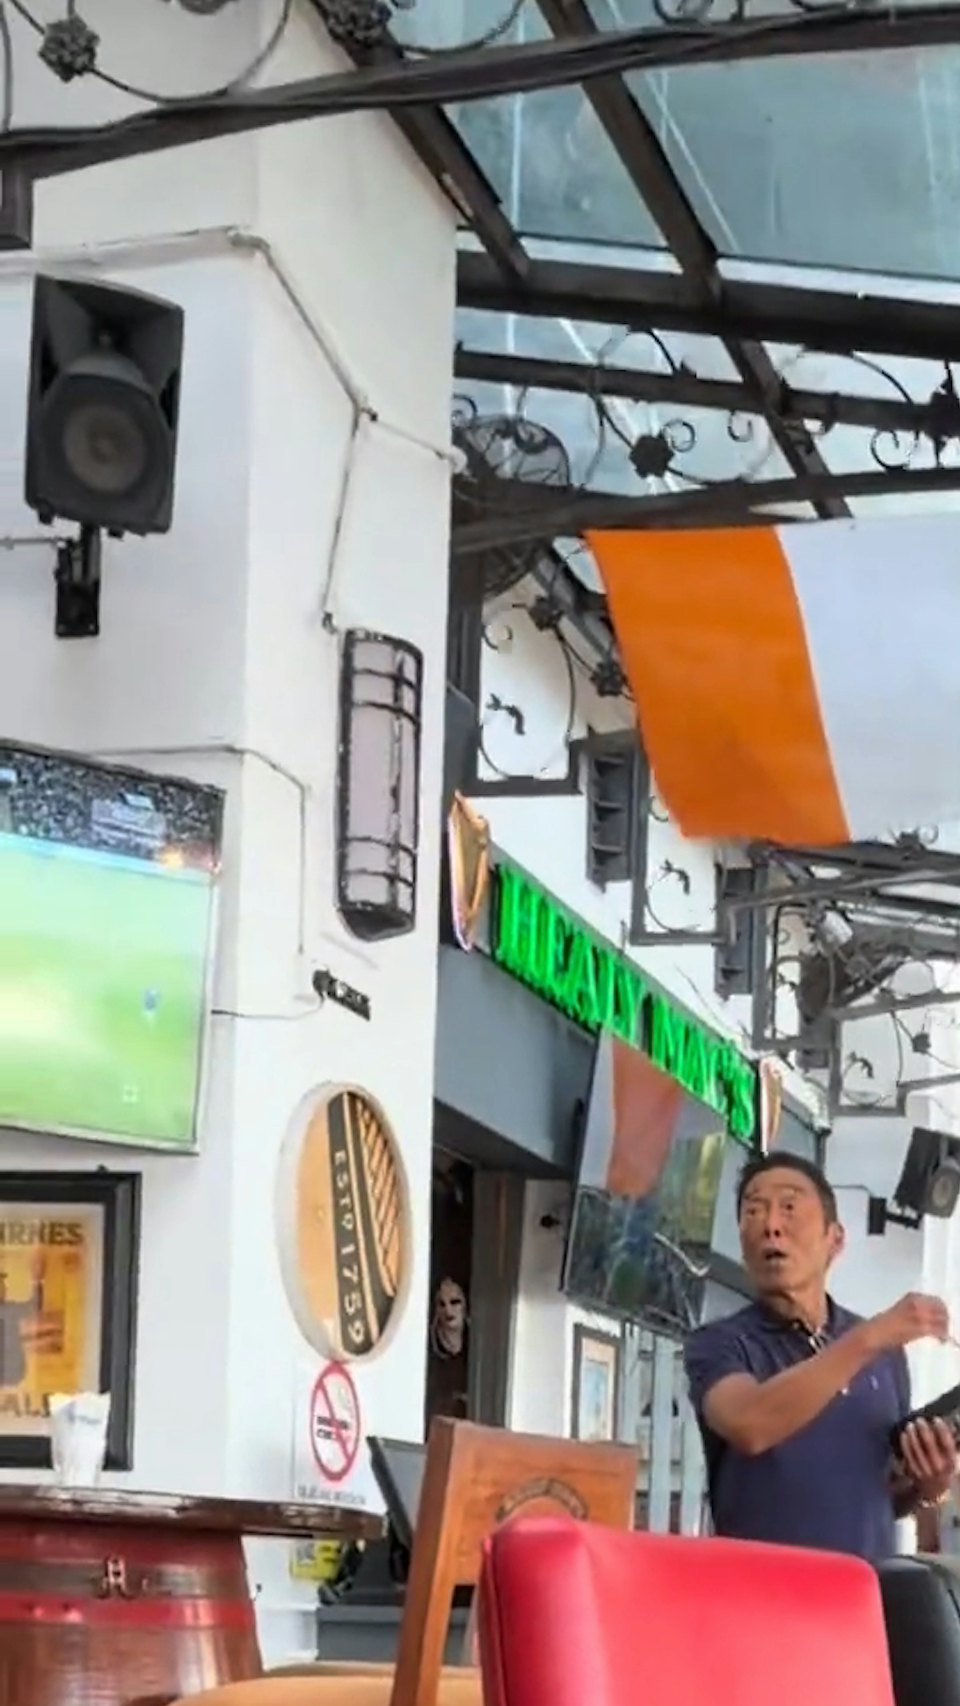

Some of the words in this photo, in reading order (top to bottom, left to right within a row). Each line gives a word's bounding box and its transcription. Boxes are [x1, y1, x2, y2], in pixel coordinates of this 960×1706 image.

[497, 866, 646, 1046] HEALY
[652, 994, 757, 1142] MAC'S
[341, 1243, 365, 1345] 1759
